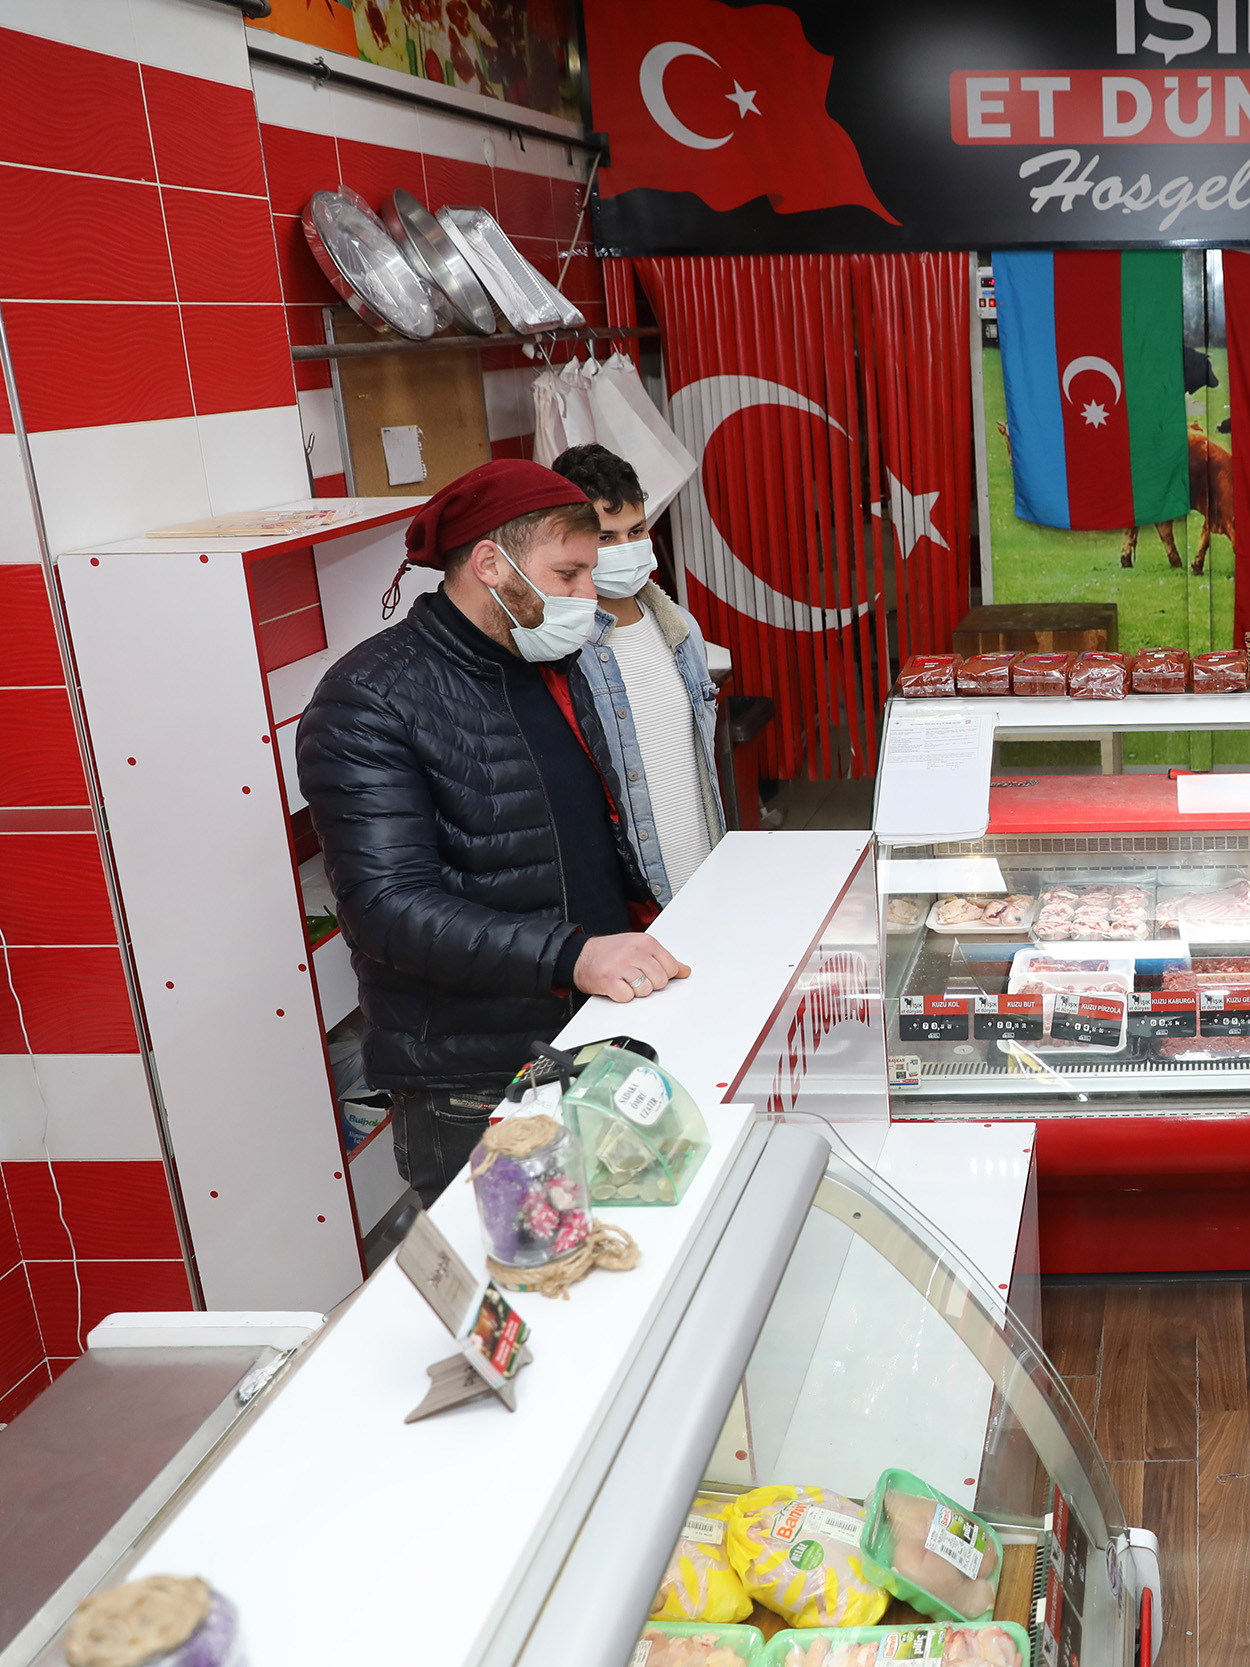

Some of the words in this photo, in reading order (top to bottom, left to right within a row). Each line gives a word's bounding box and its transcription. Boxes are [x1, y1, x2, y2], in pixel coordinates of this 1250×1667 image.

[965, 76, 1071, 138] ET
[1081, 1003, 1097, 1011] KUZU
[1097, 1005, 1121, 1014] PİRZOLA
[619, 1083, 640, 1104] SADAKA
[912, 1633, 927, 1655] piliç
